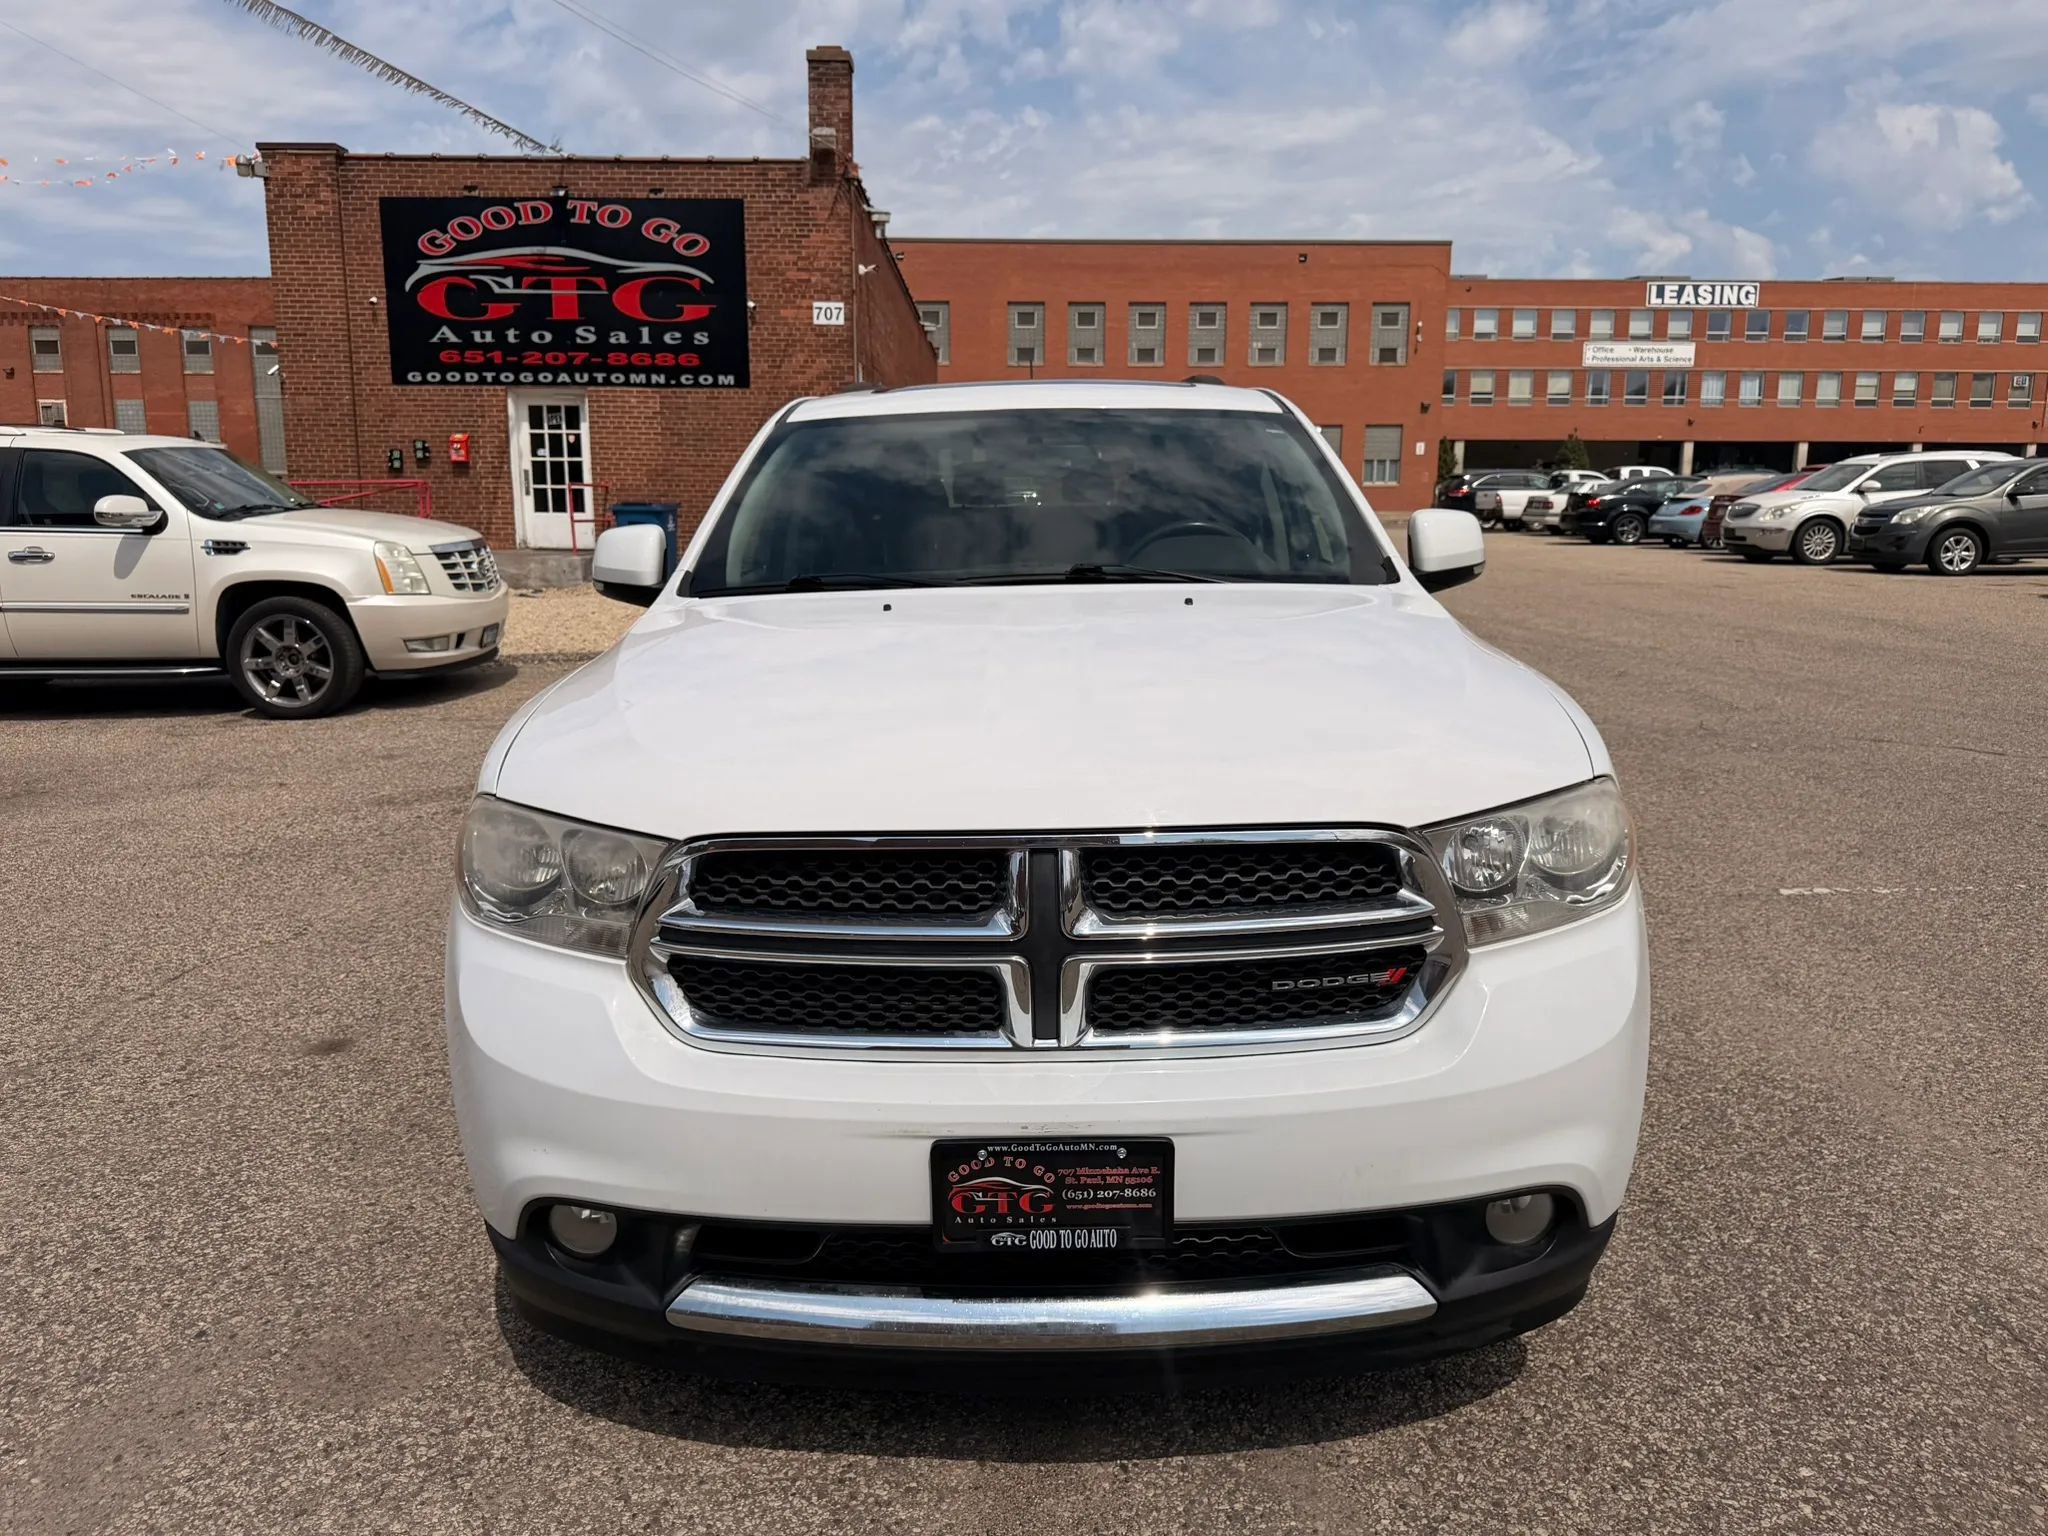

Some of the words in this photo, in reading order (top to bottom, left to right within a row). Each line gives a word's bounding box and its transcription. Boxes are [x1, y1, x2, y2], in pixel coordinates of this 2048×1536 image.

[417, 200, 553, 256] GOOD
[567, 200, 632, 228] TO
[641, 217, 710, 257] GO
[417, 276, 717, 322] GTG
[1650, 285, 1756, 305] LEASING
[814, 306, 843, 321] 707
[429, 325, 553, 345] Auto
[574, 326, 711, 345] Sales
[439, 350, 700, 367] 651-207-8686
[407, 371, 736, 386] GOODTOGOAUTOMN.COM
[1272, 970, 1391, 991] DODGE
[987, 1143, 1118, 1152] www.GoodToGoAutoMN.com
[948, 1157, 995, 1182] GOOD
[1003, 1156, 1027, 1169] TO
[1033, 1165, 1056, 1184] GO
[1058, 1169, 1075, 1177] 707
[1106, 1176, 1123, 1184] MN
[951, 1192, 1056, 1214] GTG
[1062, 1189, 1094, 1200] (651)
[1097, 1188, 1156, 1199] 207-8686
[955, 1216, 997, 1224] Auto
[1006, 1216, 1057, 1224] Sales
[1030, 1230, 1056, 1249] GOOD
[1059, 1230, 1072, 1249] TO
[1074, 1229, 1088, 1249] GO
[1090, 1229, 1117, 1248] AUTO
